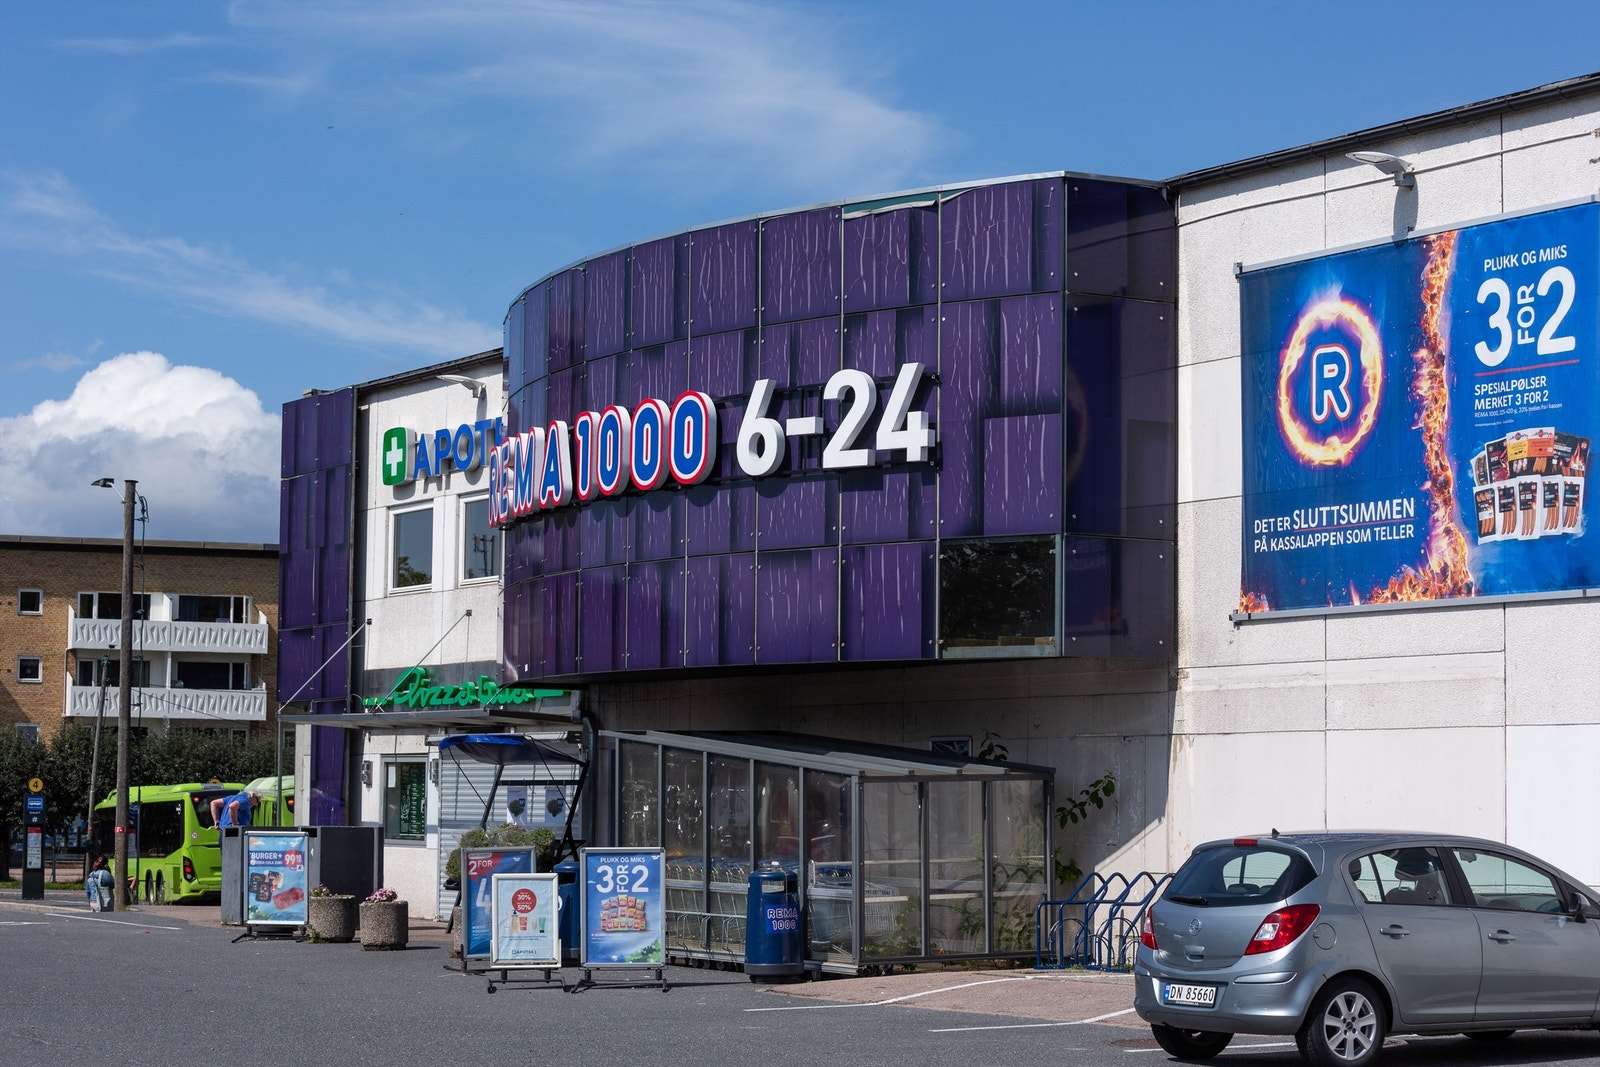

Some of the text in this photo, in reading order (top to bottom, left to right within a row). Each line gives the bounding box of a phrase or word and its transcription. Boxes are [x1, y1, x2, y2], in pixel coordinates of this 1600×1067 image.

[1484, 244, 1568, 273] PLUKK OG MIKS
[1474, 265, 1576, 367] 3 FOR 2
[1311, 343, 1352, 424] R
[1474, 375, 1547, 396] SPESIALPØLSER
[1474, 389, 1549, 411] MERKET 3 FOR 2
[736, 362, 936, 477] 6-24
[488, 390, 717, 529] REMA 1000
[1254, 497, 1415, 534] DET ER SLUTTSUMMEN
[1254, 524, 1414, 553] PÅ KASSALAPPEN SOM TELLER
[32, 780, 39, 789] 4
[284, 854, 295, 865] 99
[468, 861, 478, 875] 2
[596, 864, 649, 893] 3 FOR 2
[767, 908, 798, 919] REMA
[772, 919, 797, 931] 1000
[1170, 985, 1214, 1002] DN 85660
